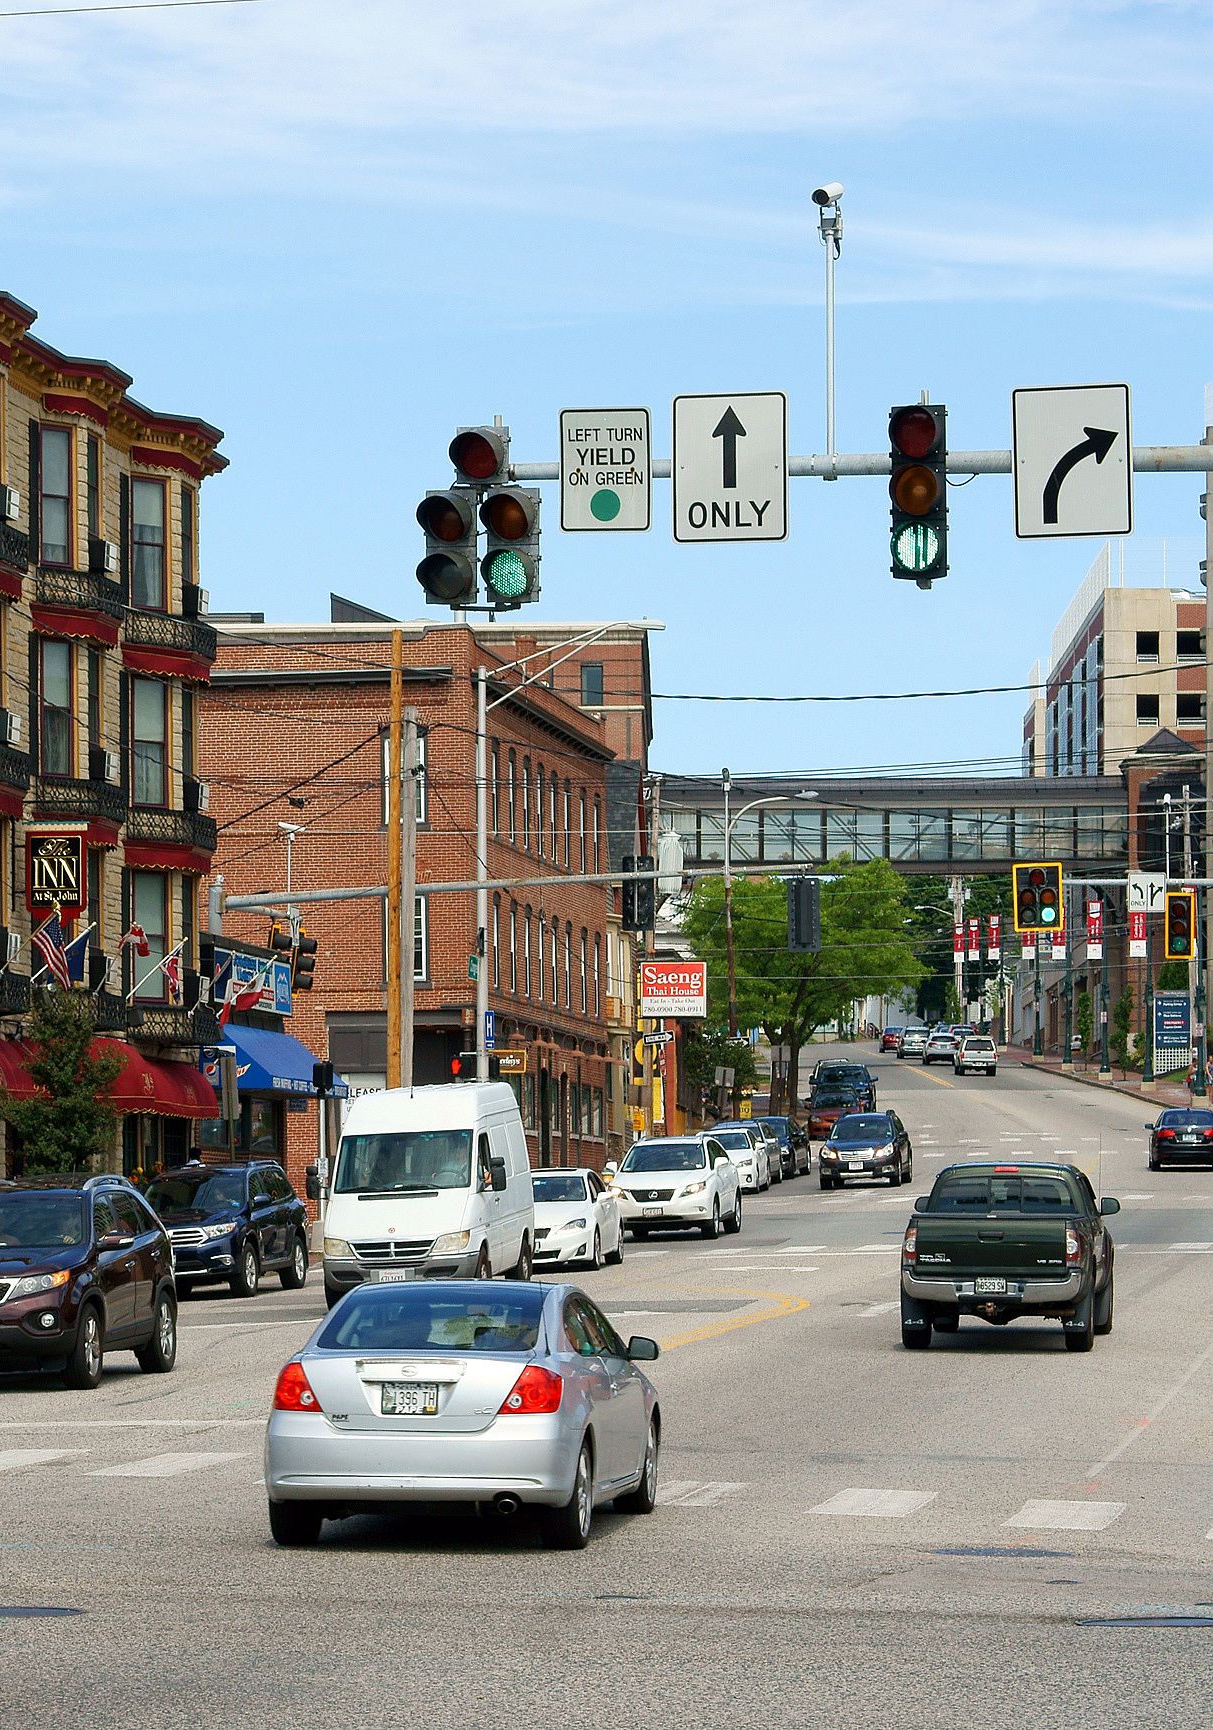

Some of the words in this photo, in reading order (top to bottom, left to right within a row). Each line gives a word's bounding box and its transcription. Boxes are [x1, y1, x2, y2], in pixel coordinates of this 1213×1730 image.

[568, 428, 600, 442] LEFT
[606, 428, 643, 441] TURN
[576, 447, 635, 466] YIELD
[569, 472, 588, 486] ON
[595, 471, 643, 485] GREEN
[688, 500, 771, 529] ONLY
[38, 839, 72, 856] The
[33, 858, 76, 888] INN
[57, 890, 78, 900] John
[644, 966, 702, 989] Saeng
[647, 986, 667, 995] Thai
[670, 986, 699, 995] House
[393, 1391, 418, 1406] 1396
[422, 1391, 435, 1406] TH
